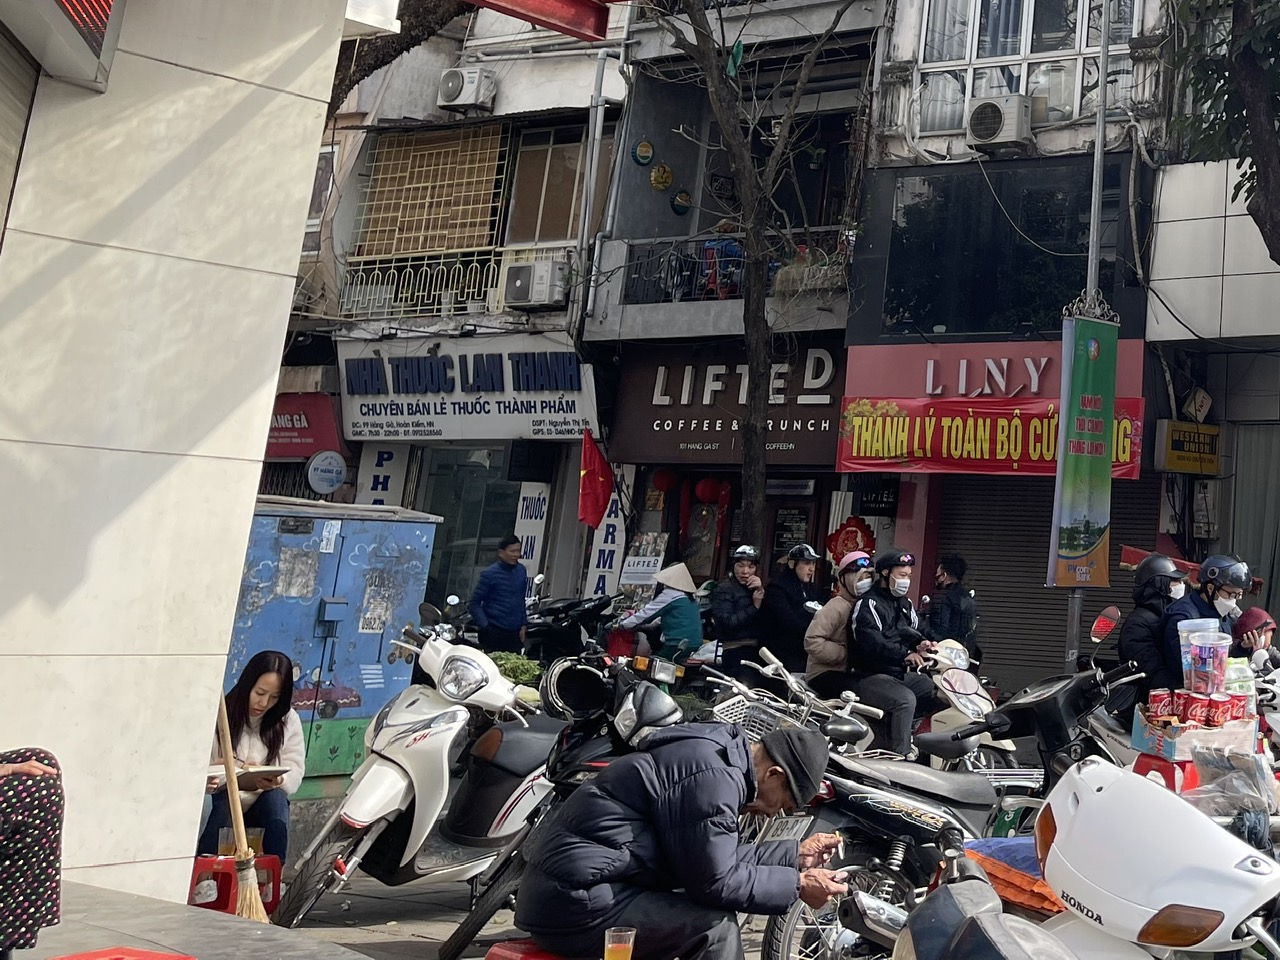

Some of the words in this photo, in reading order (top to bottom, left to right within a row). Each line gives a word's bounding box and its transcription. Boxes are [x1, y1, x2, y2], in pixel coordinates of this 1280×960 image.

[345, 349, 389, 395] NHÀ
[388, 343, 455, 395] THUỐC
[458, 352, 504, 393] LAN
[508, 350, 582, 392] THANH
[652, 348, 835, 405] LIFTED
[360, 400, 404, 416] CHUYÊN
[407, 399, 431, 416] BÁN
[434, 396, 447, 415] LẺ
[450, 396, 491, 414] THUỐC
[495, 397, 537, 414] THÀNH
[541, 393, 577, 414] PHẨM
[293, 411, 308, 428] GÀ
[653, 420, 723, 431] COFFEE
[731, 420, 739, 431] &
[768, 420, 830, 431] RUNCH
[913, 407, 936, 458] LÝ
[941, 408, 991, 460] TOÀN
[996, 409, 1023, 470] BỘ
[1028, 403, 1059, 462] CỬ
[1172, 430, 1211, 444] WESTERN
[1184, 442, 1211, 453] UNION
[520, 491, 547, 520] THUỐC
[627, 559, 659, 568] LIFTED
[1060, 889, 1105, 927] HONDA
